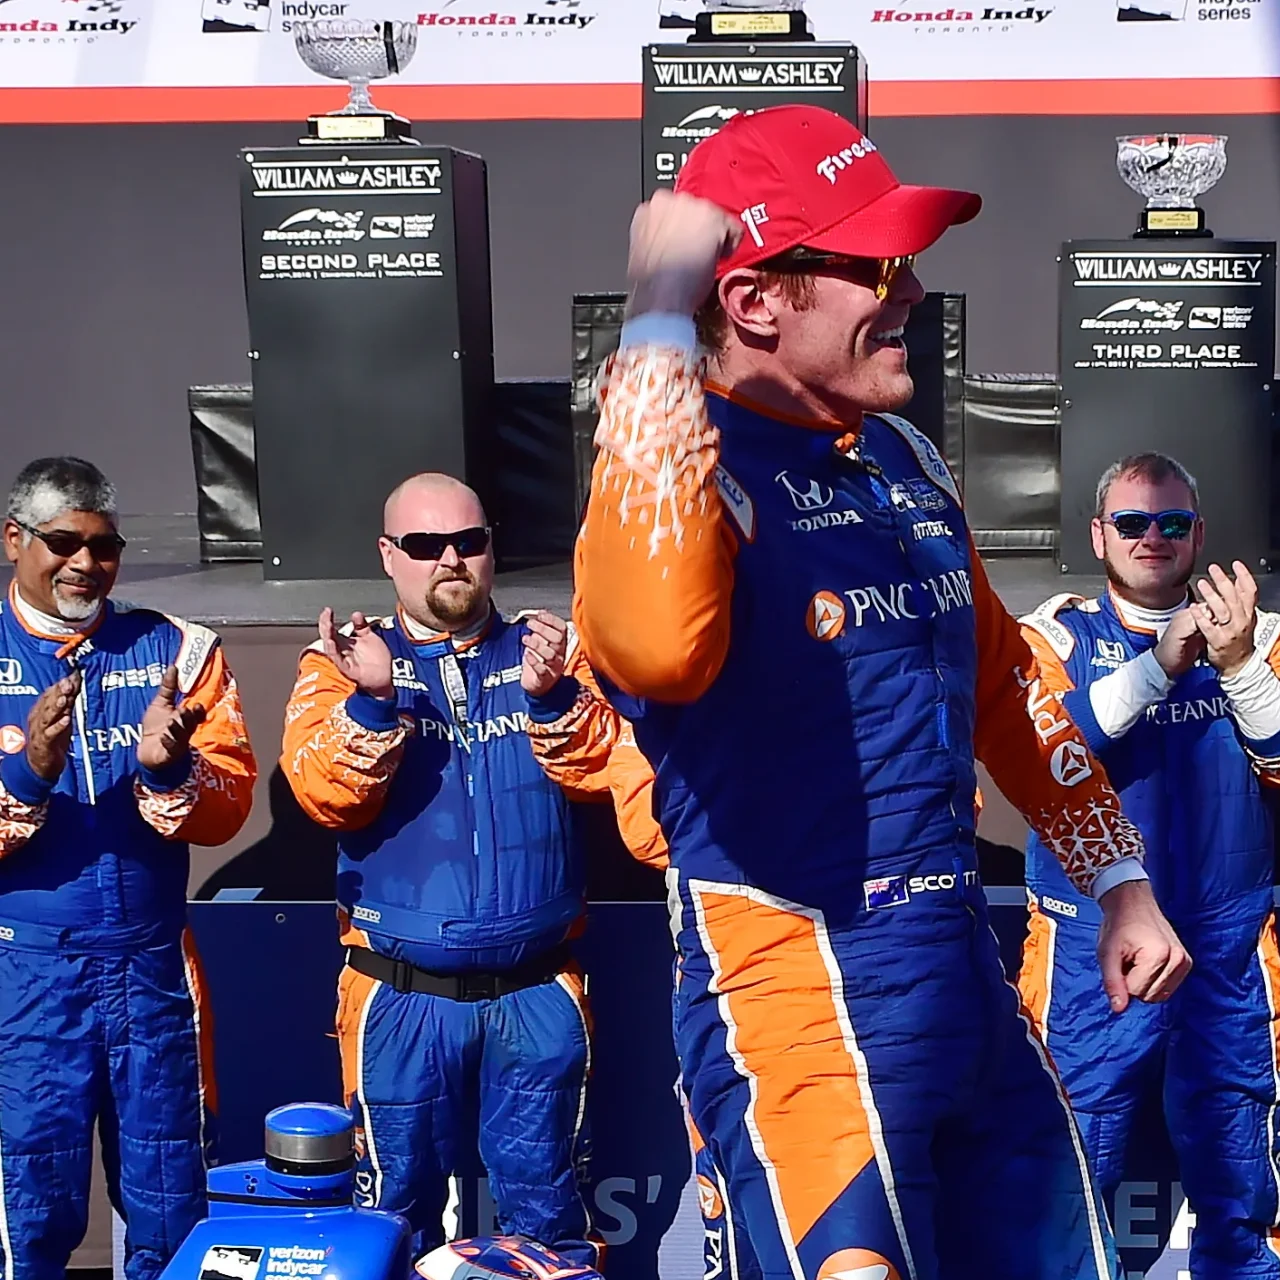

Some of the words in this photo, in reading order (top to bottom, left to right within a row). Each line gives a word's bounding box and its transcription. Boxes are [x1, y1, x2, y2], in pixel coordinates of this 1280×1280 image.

[281, 1, 346, 19] indycar
[870, 8, 974, 22] Honda
[980, 8, 1053, 24] Indy
[1198, 7, 1251, 21] series
[0, 20, 58, 32] nda
[65, 19, 137, 34] Indy
[416, 13, 517, 26] Honda
[523, 12, 595, 29] Indy
[654, 64, 738, 85] WILLIAM
[762, 63, 844, 85] ASHLEY
[253, 168, 336, 189] WILLIAM
[359, 166, 440, 188] ASHLEY
[740, 202, 770, 248] 1ST
[261, 254, 358, 270] SECOND
[368, 253, 441, 269] PLACE
[1075, 259, 1158, 280] WILLIAM
[1180, 259, 1263, 280] ASHLEY
[1092, 344, 1163, 359] THIRD
[1171, 344, 1241, 359] PLACE
[393, 679, 429, 691] NDA
[909, 870, 977, 893] SCOTT
[1043, 896, 1078, 917] sparco
[269, 1246, 326, 1261] verizon
[267, 1259, 328, 1277] indycar
